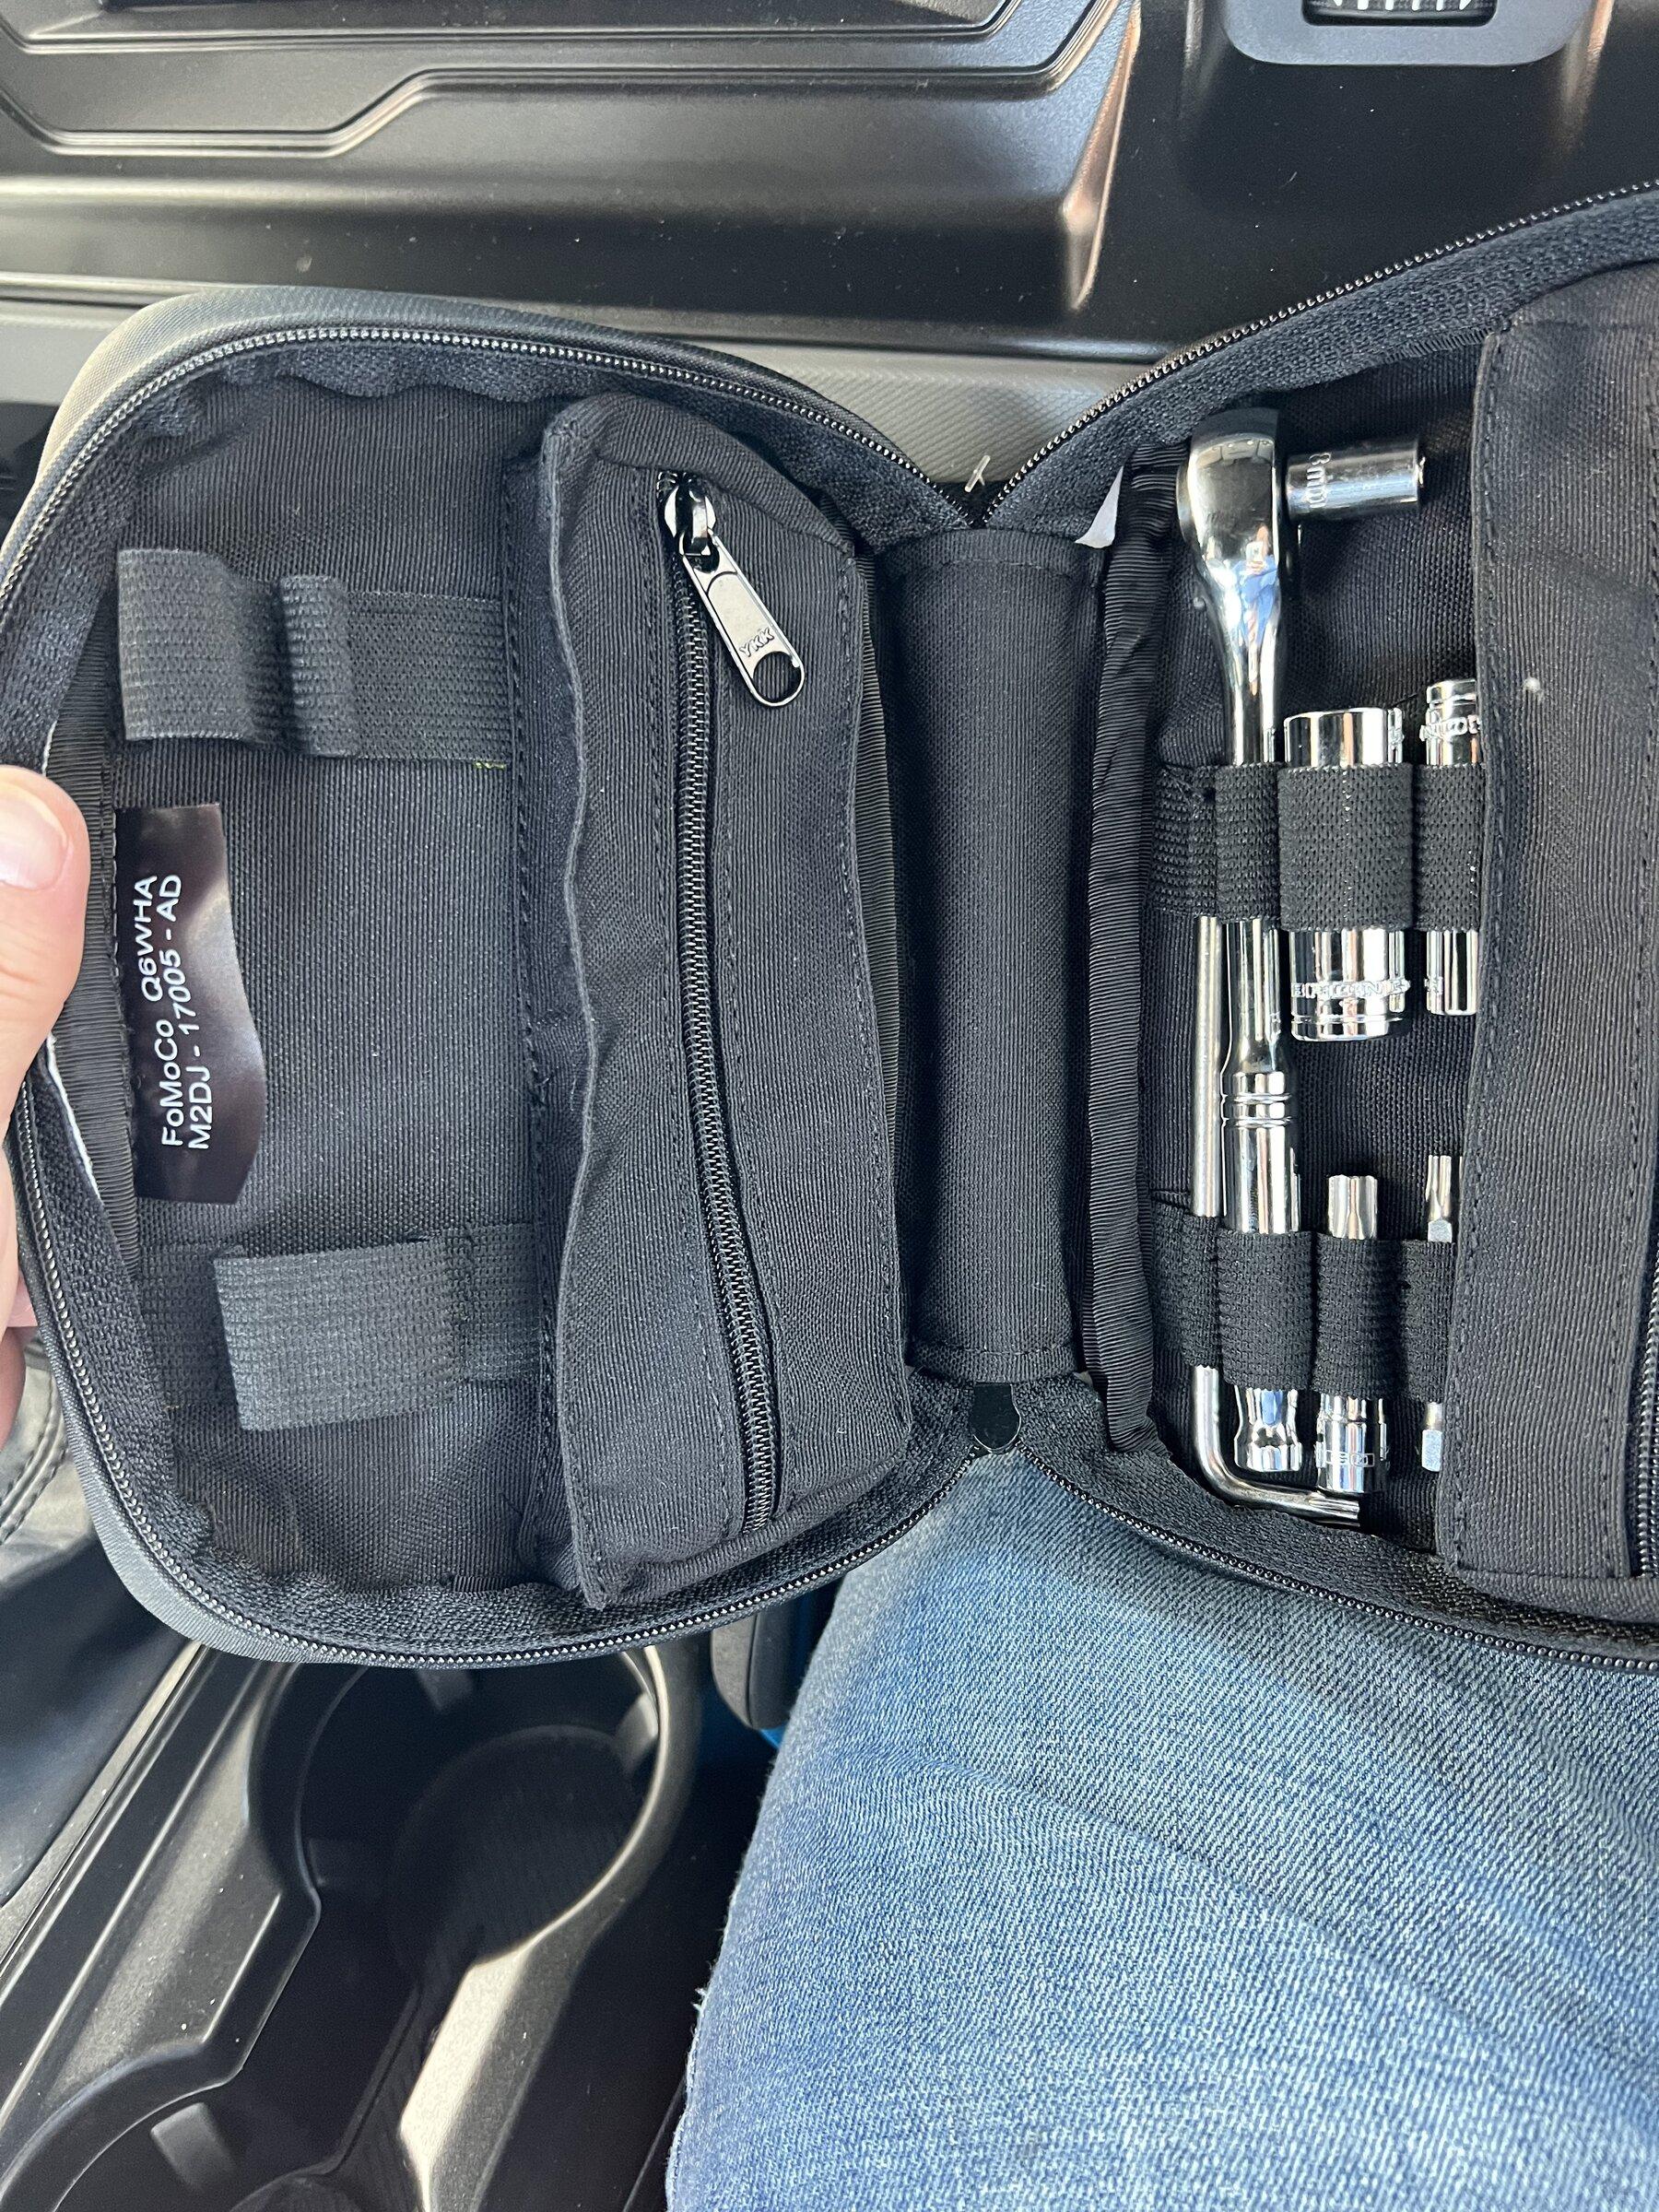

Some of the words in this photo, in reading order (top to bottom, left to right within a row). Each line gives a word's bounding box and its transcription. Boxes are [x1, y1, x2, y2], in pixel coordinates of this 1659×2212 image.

[739, 627, 775, 657] YKK
[157, 875, 182, 923] AD
[133, 876, 164, 1002] Q6WHA
[165, 928, 172, 941] -
[159, 948, 200, 1036] 17005
[154, 1019, 184, 1146] FoMoCo
[194, 1045, 201, 1057] -
[186, 1065, 213, 1149] M2DJ
